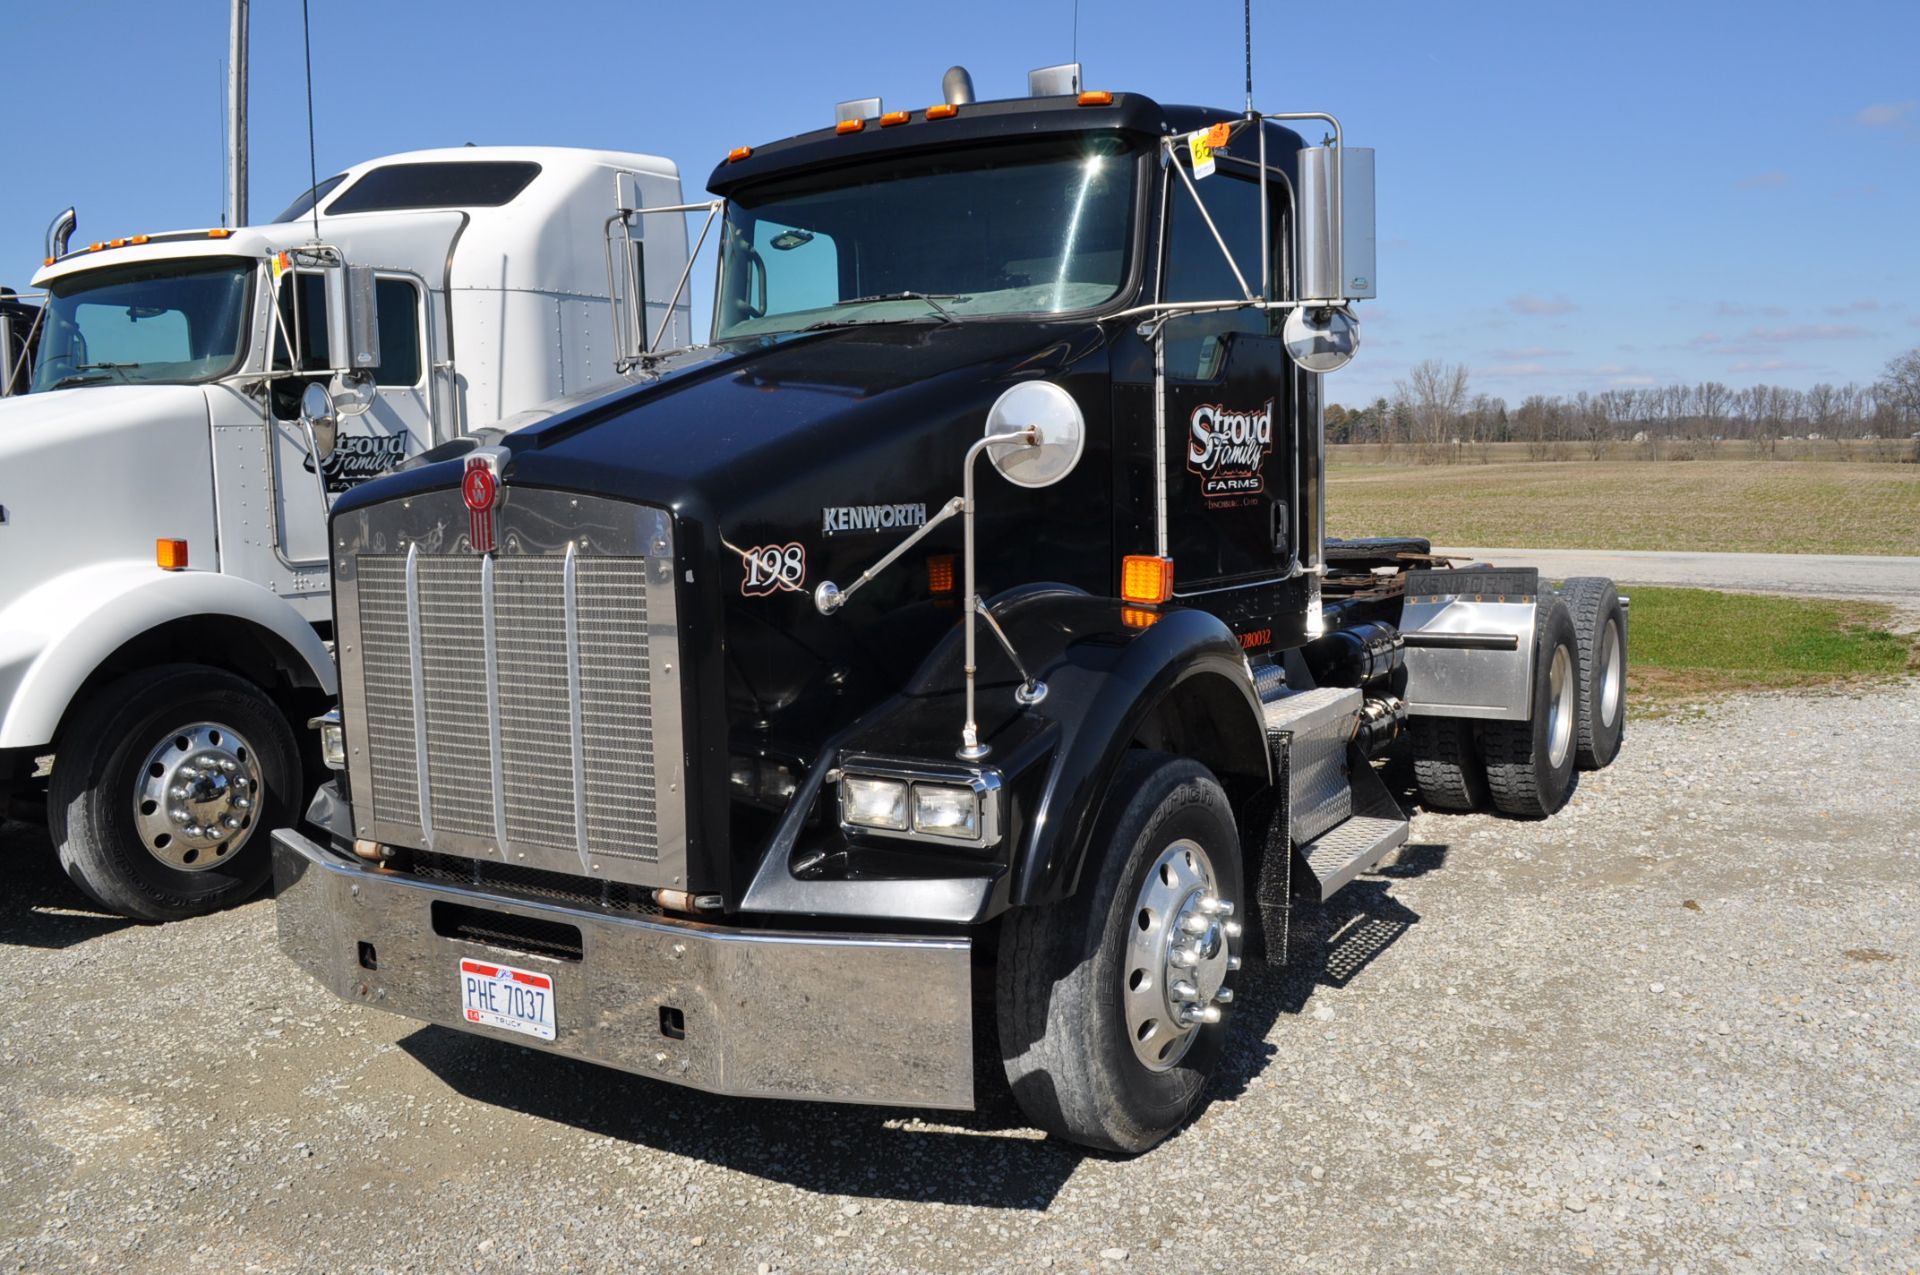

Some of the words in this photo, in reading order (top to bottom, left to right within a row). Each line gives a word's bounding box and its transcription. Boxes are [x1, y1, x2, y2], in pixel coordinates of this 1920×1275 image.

[304, 430, 407, 467] troud
[1189, 400, 1273, 464] Stroud
[1201, 429, 1264, 471] Family
[323, 447, 396, 475] Family
[1207, 478, 1259, 491] FARMS
[822, 502, 928, 532] KENWORTH
[746, 547, 803, 588] 198
[467, 977, 499, 1013] PHE
[503, 984, 545, 1023] 7037
